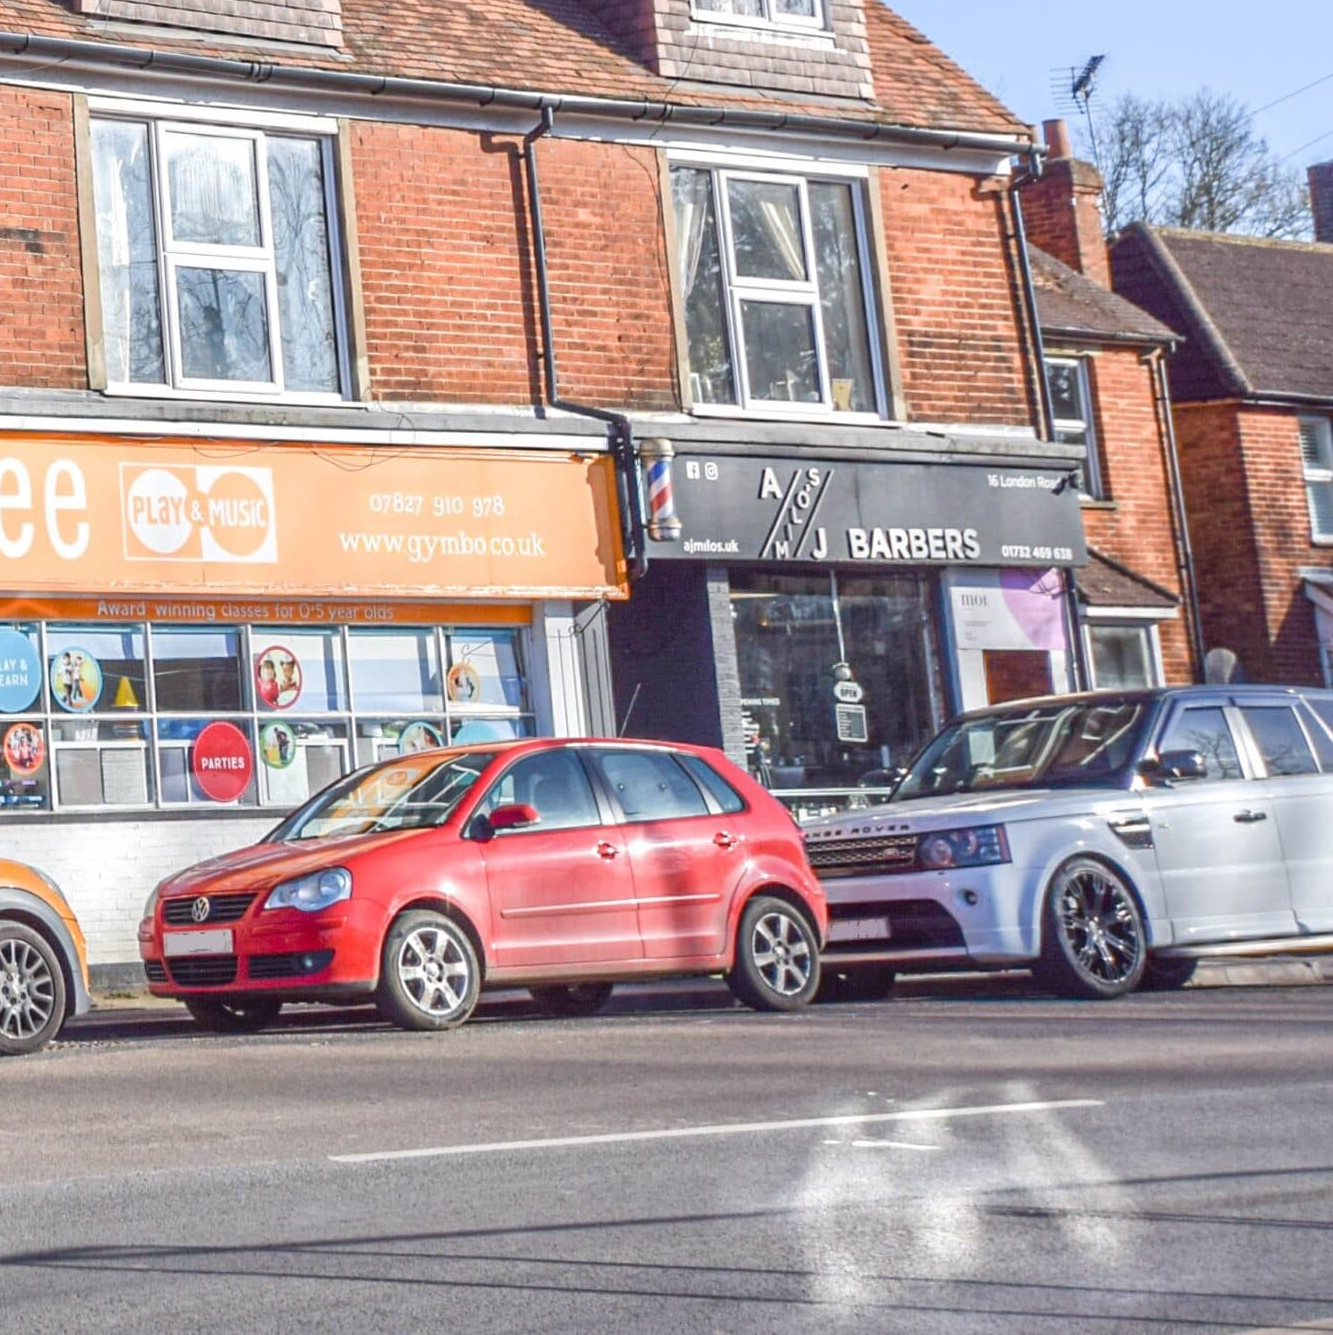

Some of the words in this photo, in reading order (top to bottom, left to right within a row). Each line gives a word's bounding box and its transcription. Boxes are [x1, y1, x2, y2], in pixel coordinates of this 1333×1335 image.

[761, 466, 783, 499] A
[987, 474, 998, 487] 16
[1000, 474, 1036, 489] London
[191, 498, 205, 523] &
[369, 491, 423, 515] 07827
[434, 496, 464, 517] 910
[472, 495, 505, 518] 978
[339, 529, 547, 563] www.gymbo.co.uk
[683, 538, 740, 554] ajmilos.uk
[812, 527, 829, 559] J
[848, 527, 981, 559] BARBERS
[1001, 545, 1031, 558] 01732
[97, 600, 146, 616] Award
[155, 601, 216, 620] winning
[221, 602, 269, 618] classes
[275, 603, 295, 618] for
[328, 604, 358, 621] year
[364, 604, 394, 619] olds
[20, 658, 29, 672] &
[201, 757, 245, 770] PARTIES
[851, 824, 910, 835] ROVER
